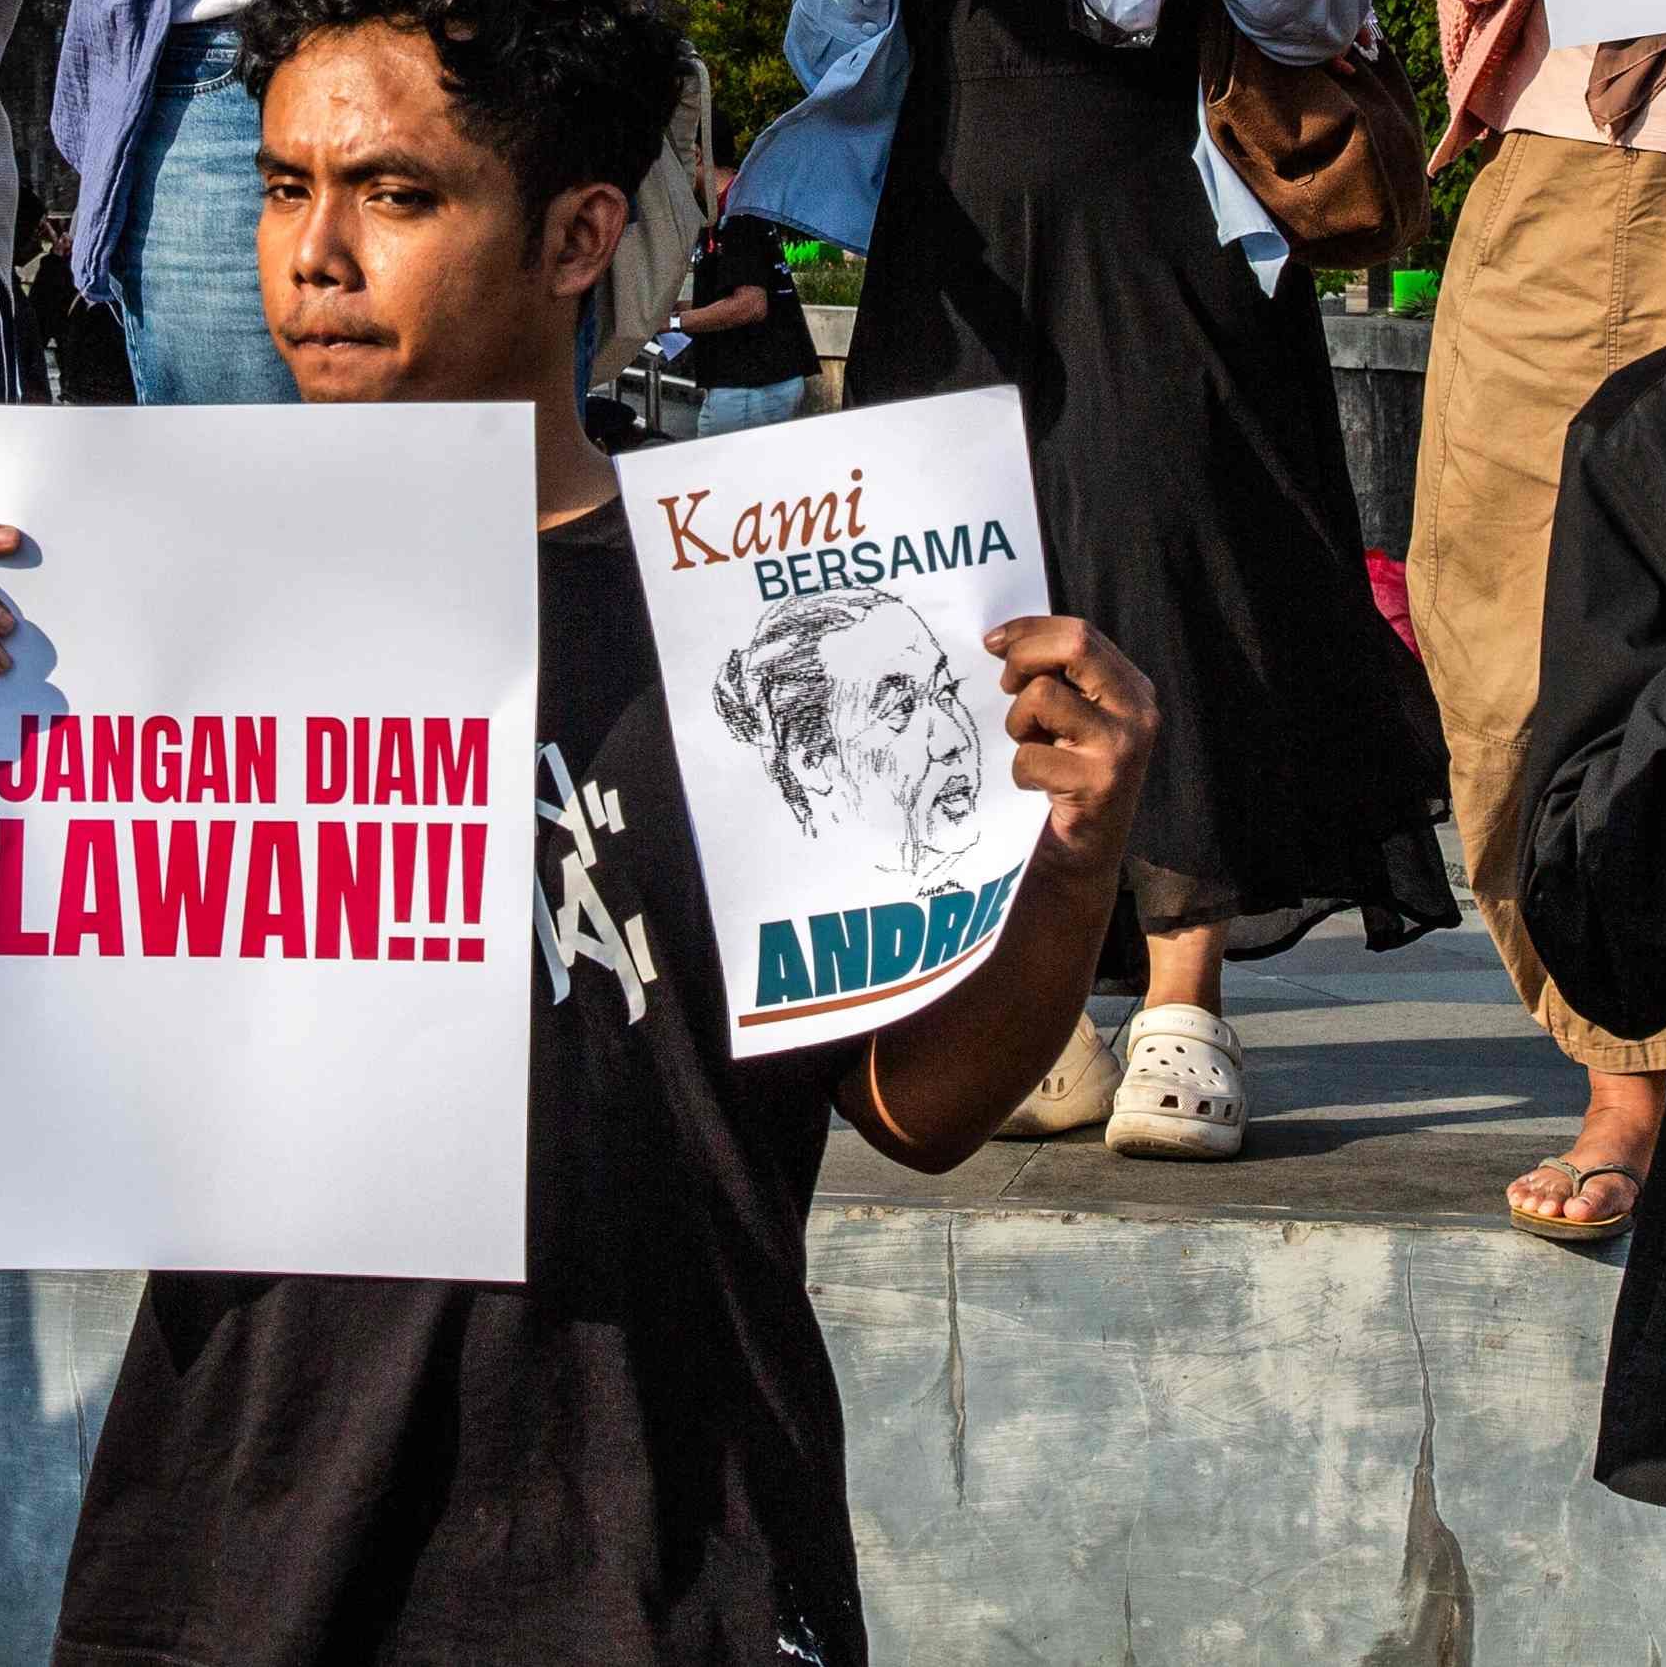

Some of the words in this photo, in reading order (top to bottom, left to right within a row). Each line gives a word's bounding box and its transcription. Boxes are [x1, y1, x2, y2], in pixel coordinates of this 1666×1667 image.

[657, 469, 866, 571] Kami
[755, 520, 1016, 602] BERSAMA
[305, 717, 490, 807] DIAM
[755, 859, 1025, 1007] ANDRIE
